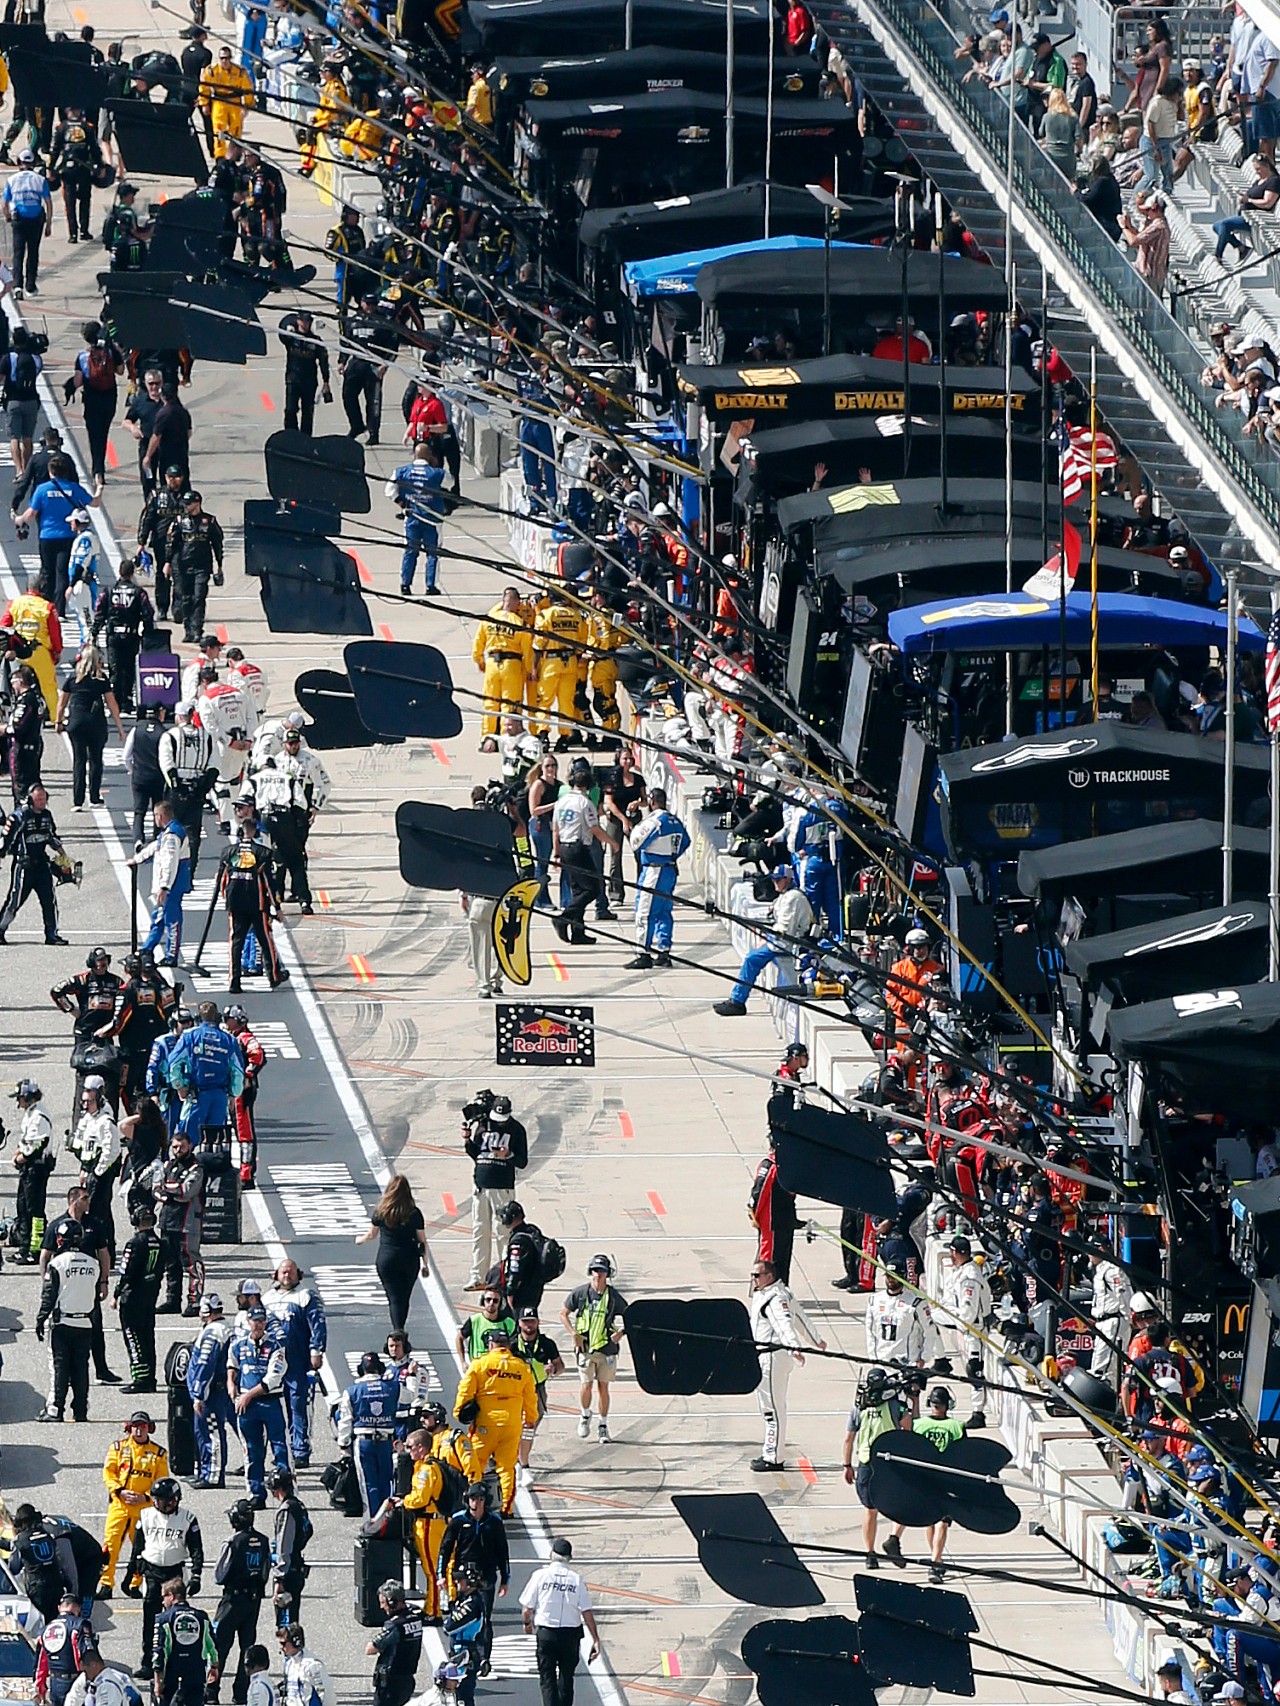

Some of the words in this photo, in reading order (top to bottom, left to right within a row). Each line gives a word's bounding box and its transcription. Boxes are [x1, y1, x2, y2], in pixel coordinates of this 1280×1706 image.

[646, 79, 683, 88] TRACKER
[603, 311, 617, 324] 8
[111, 593, 135, 608] ally
[818, 631, 839, 646] 24
[143, 673, 174, 688] ally
[1093, 769, 1170, 783] TRACKHOUSE
[512, 1037, 545, 1053] Red
[546, 1037, 578, 1054] Bull
[206, 1177, 221, 1193] 4
[1181, 1312, 1212, 1323] 23XI
[498, 1370, 522, 1380] Love's
[359, 1415, 392, 1423] NATIONAL
[867, 1410, 882, 1419] FOX
[928, 1431, 946, 1441] FOX
[542, 1582, 577, 1593] OFFICIAL
